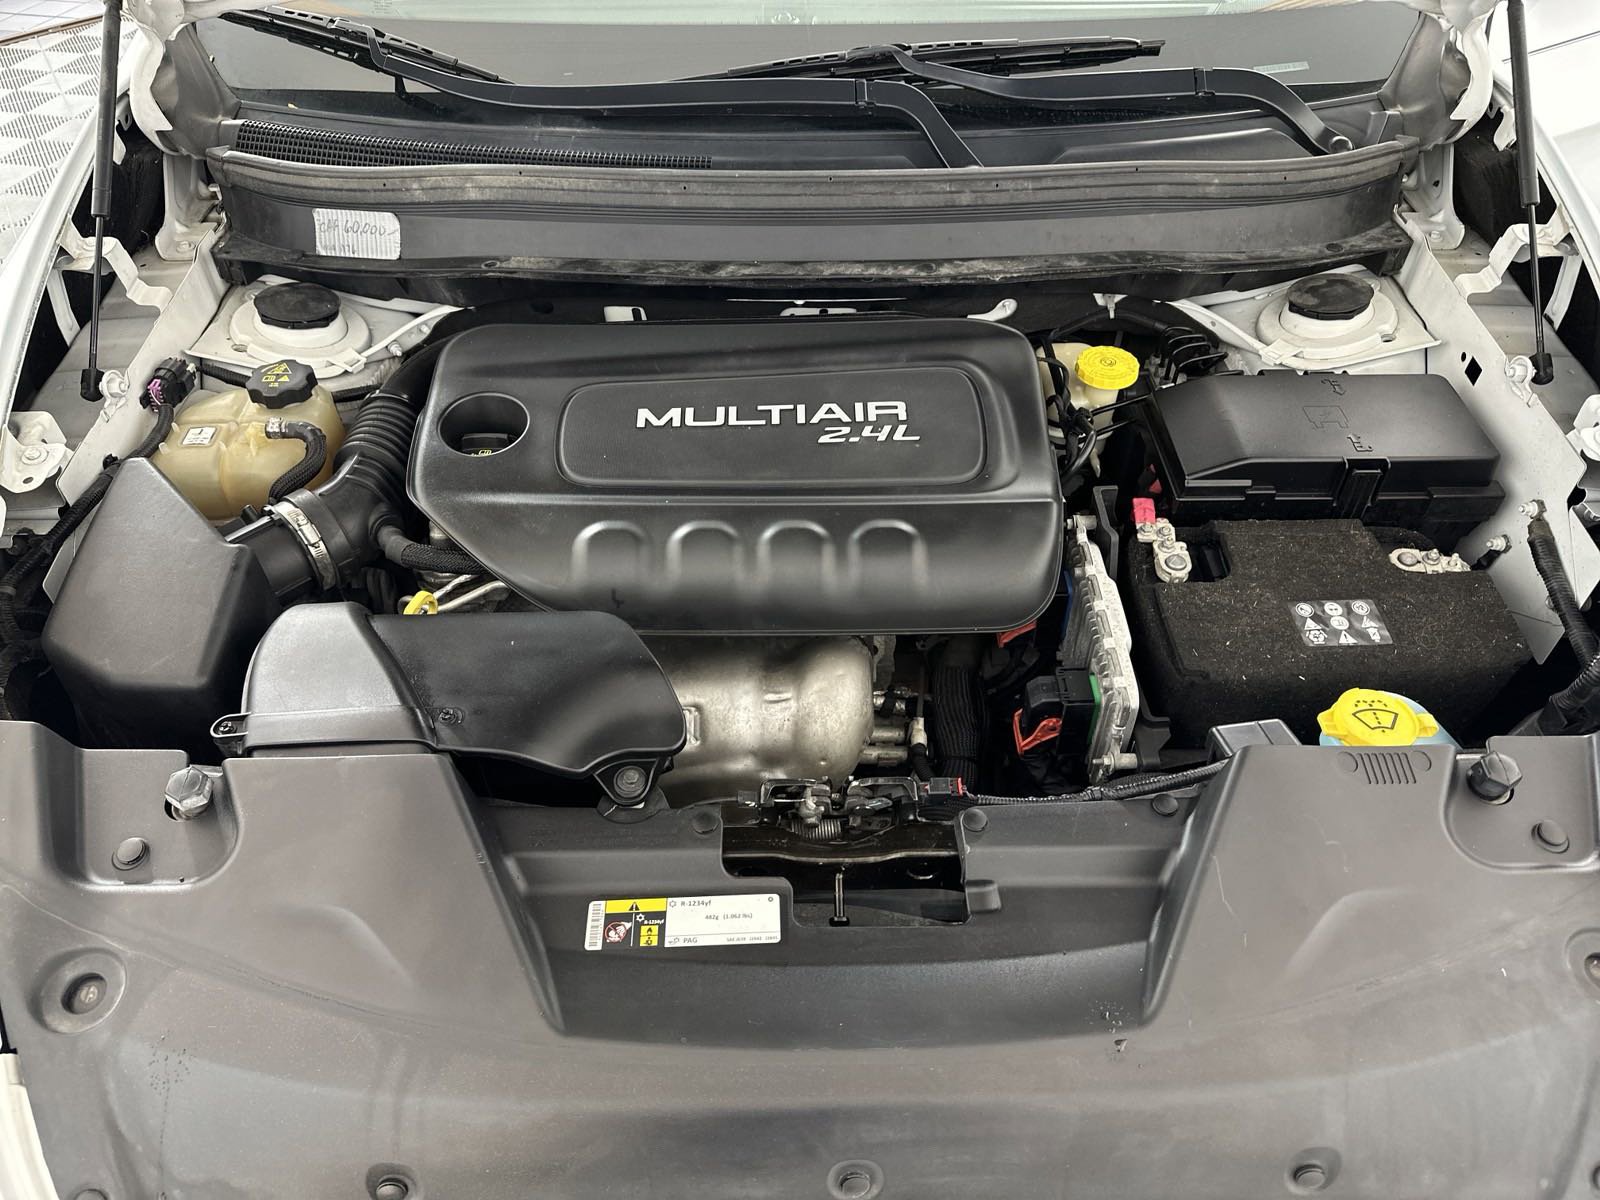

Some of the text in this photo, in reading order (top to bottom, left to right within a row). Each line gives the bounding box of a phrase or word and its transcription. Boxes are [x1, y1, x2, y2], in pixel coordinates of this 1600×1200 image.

[636, 401, 908, 428] MULTIAIR
[817, 424, 921, 443] 2.4L
[680, 899, 712, 908] R-1234yf
[682, 936, 698, 944] PAG
